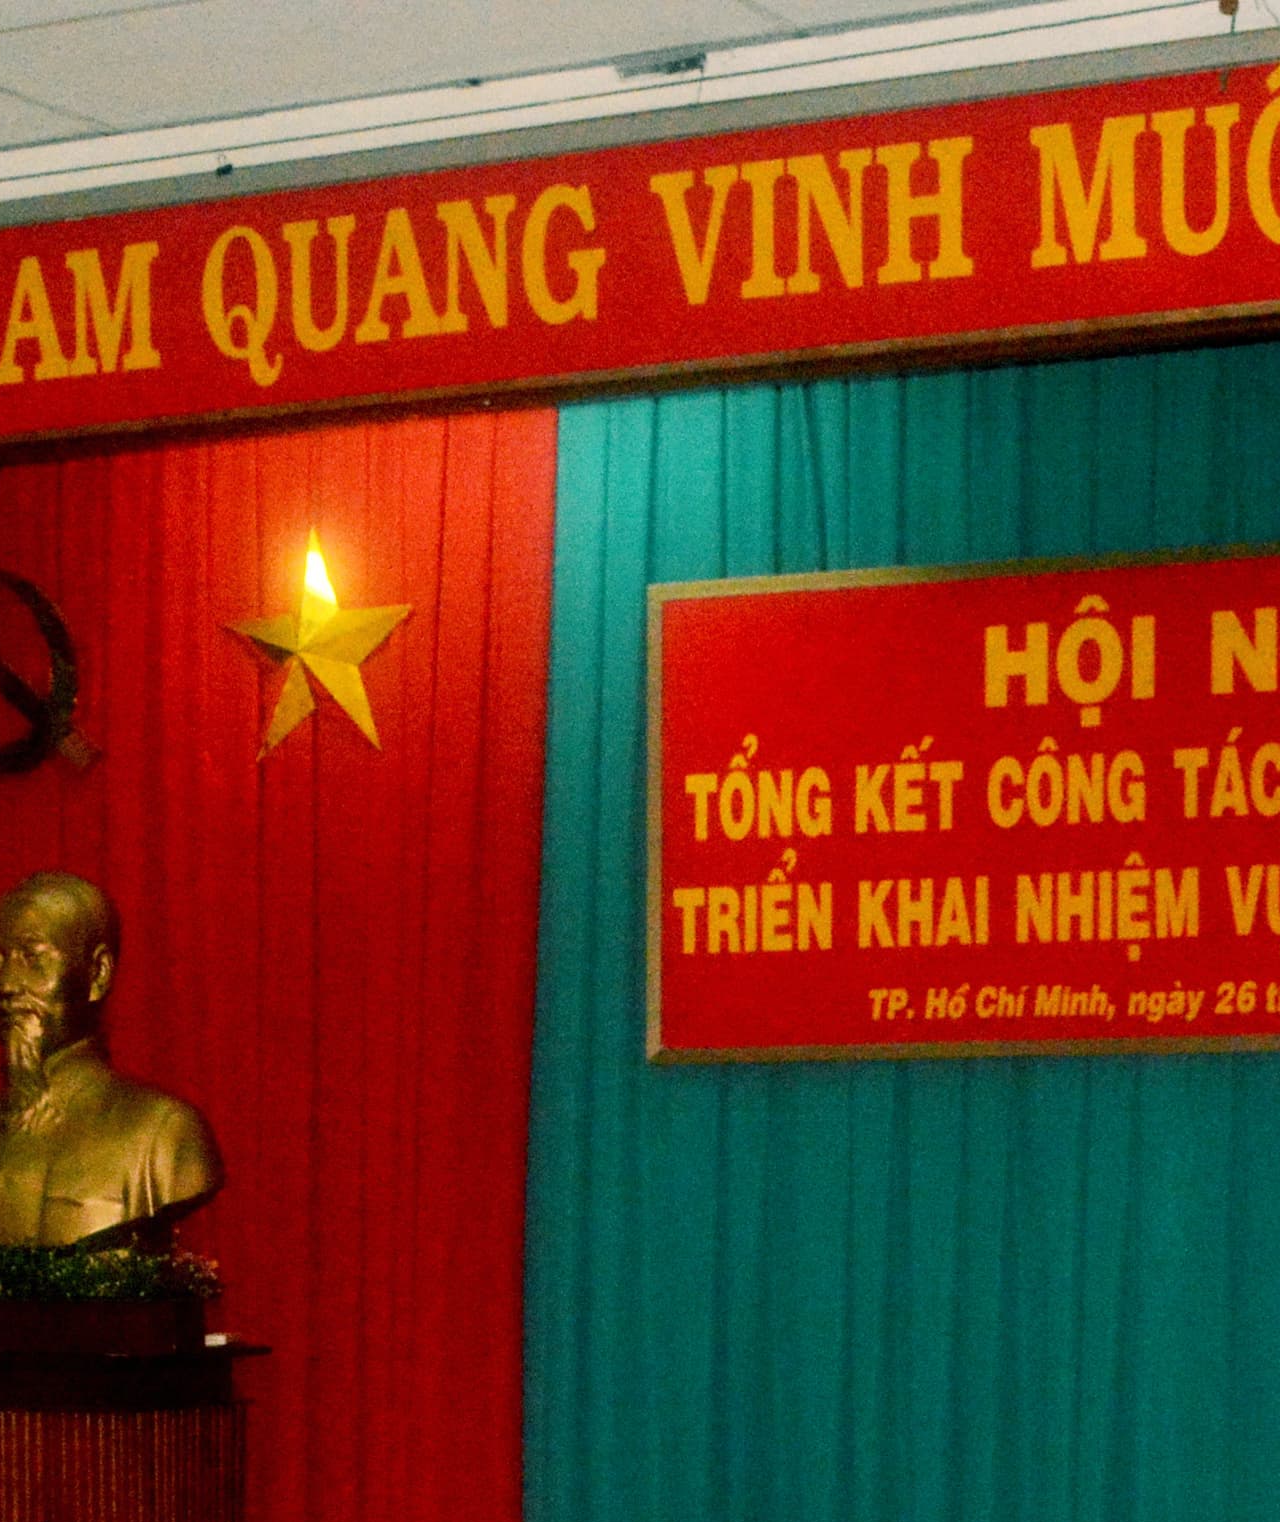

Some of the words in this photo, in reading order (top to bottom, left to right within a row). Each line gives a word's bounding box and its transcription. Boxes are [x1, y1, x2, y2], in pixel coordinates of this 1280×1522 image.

[202, 182, 606, 386] QUANG
[651, 135, 973, 306] VINH
[984, 597, 1155, 727] HỘI
[686, 732, 831, 843] TỔNG
[854, 734, 963, 832] KẾT
[987, 737, 1146, 828] CÔNG
[673, 847, 833, 957] TRIỂN
[857, 876, 988, 949] KHAI
[1014, 852, 1201, 961] NHIỆM
[869, 988, 915, 1021] TP.
[975, 982, 1024, 1018] Chí
[1034, 983, 1116, 1021] Minh,
[1128, 980, 1205, 1023] ngày
[1214, 981, 1257, 1014] 26
